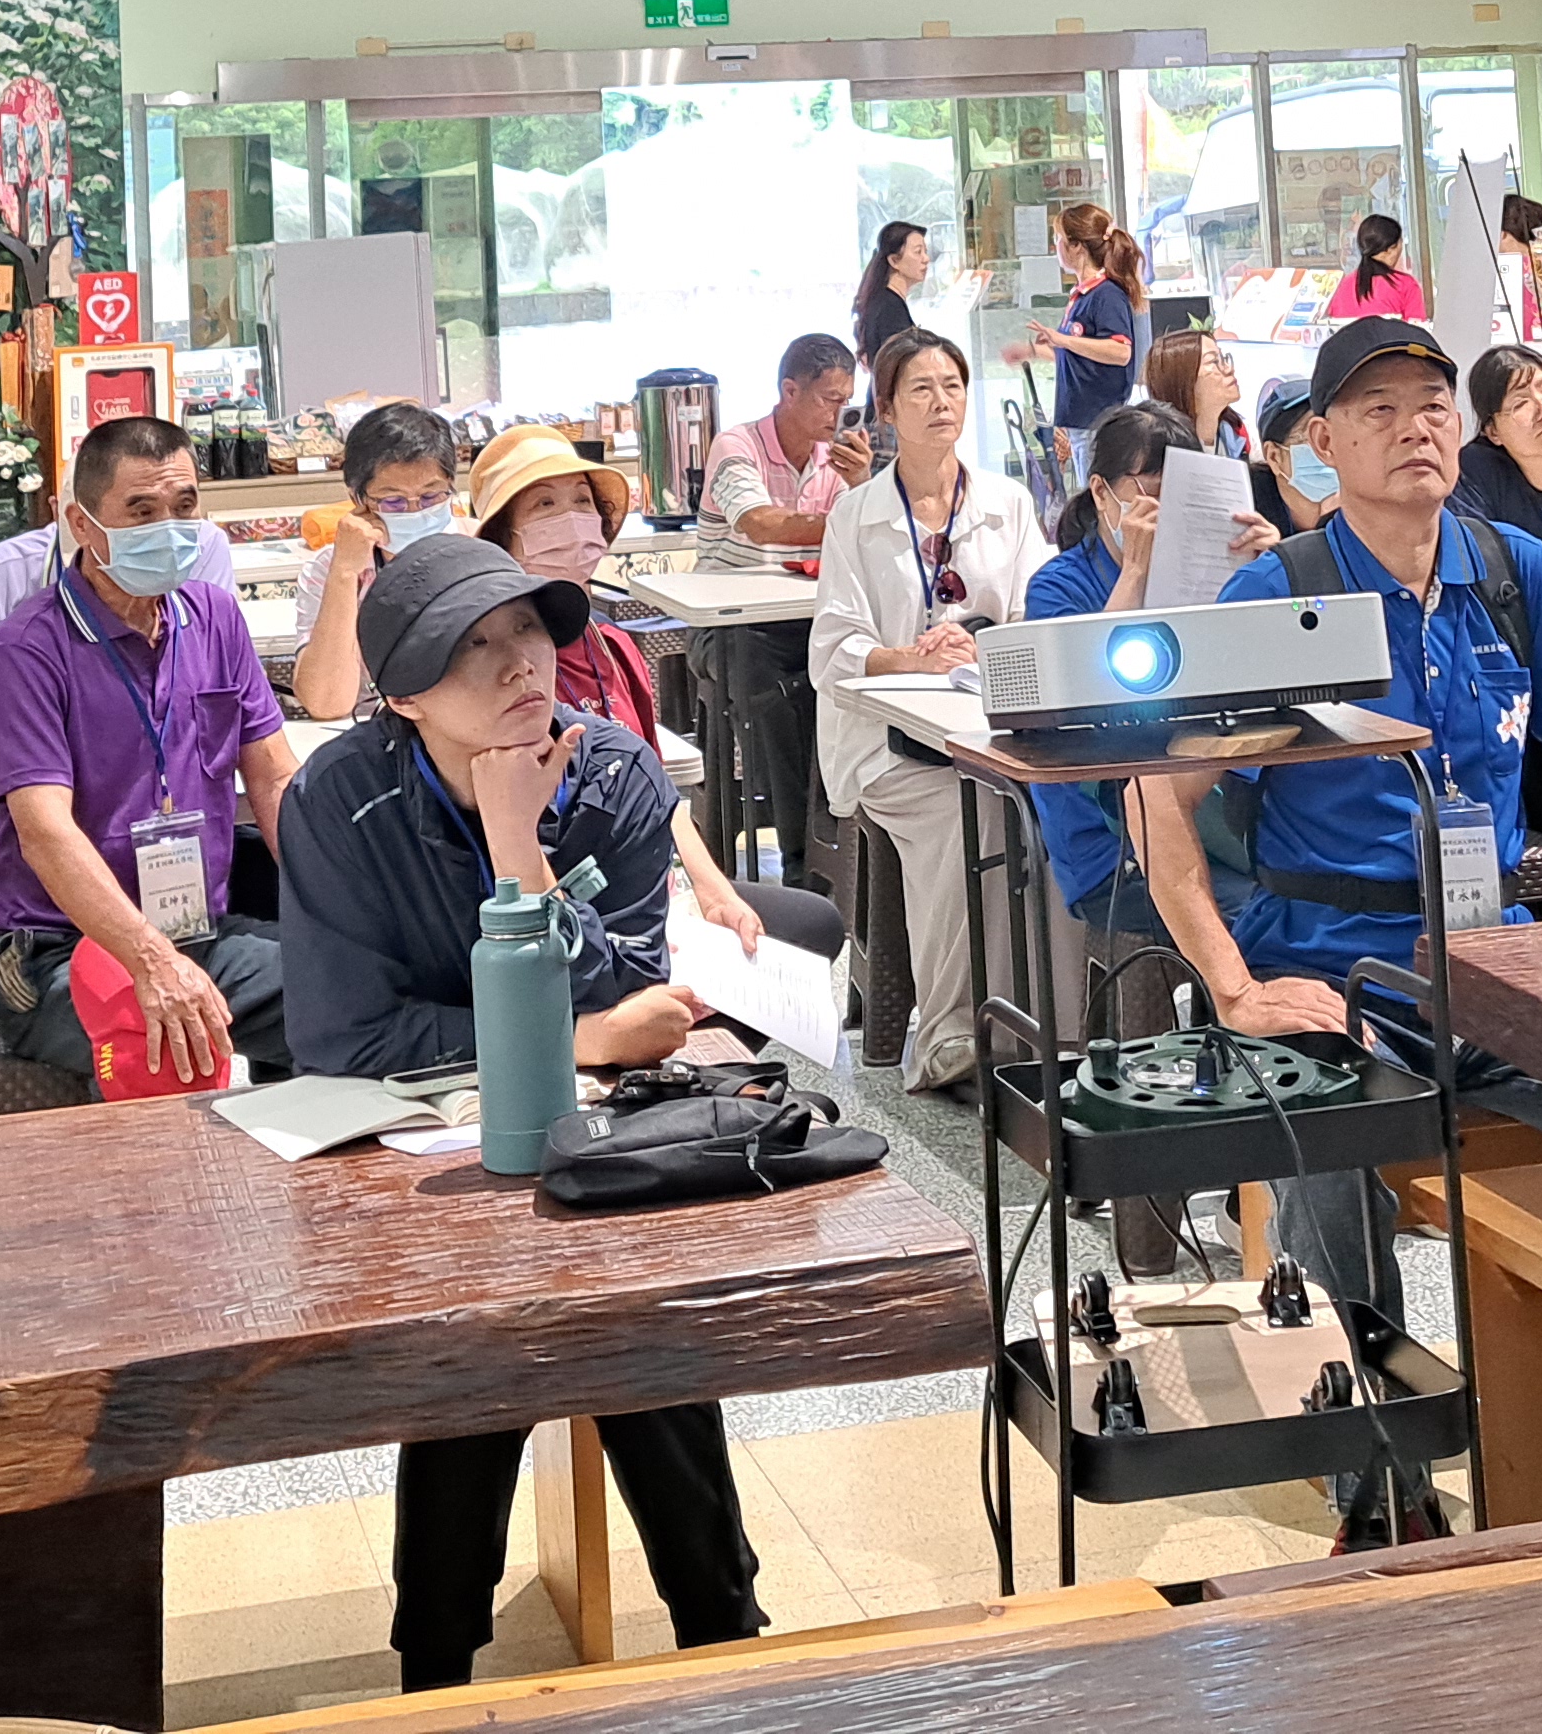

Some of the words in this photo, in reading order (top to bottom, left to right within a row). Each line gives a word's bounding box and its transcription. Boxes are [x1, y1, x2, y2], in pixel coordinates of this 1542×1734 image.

[647, 15, 675, 25] EXIT
[93, 277, 123, 292] AED
[97, 1041, 115, 1083] WHF
